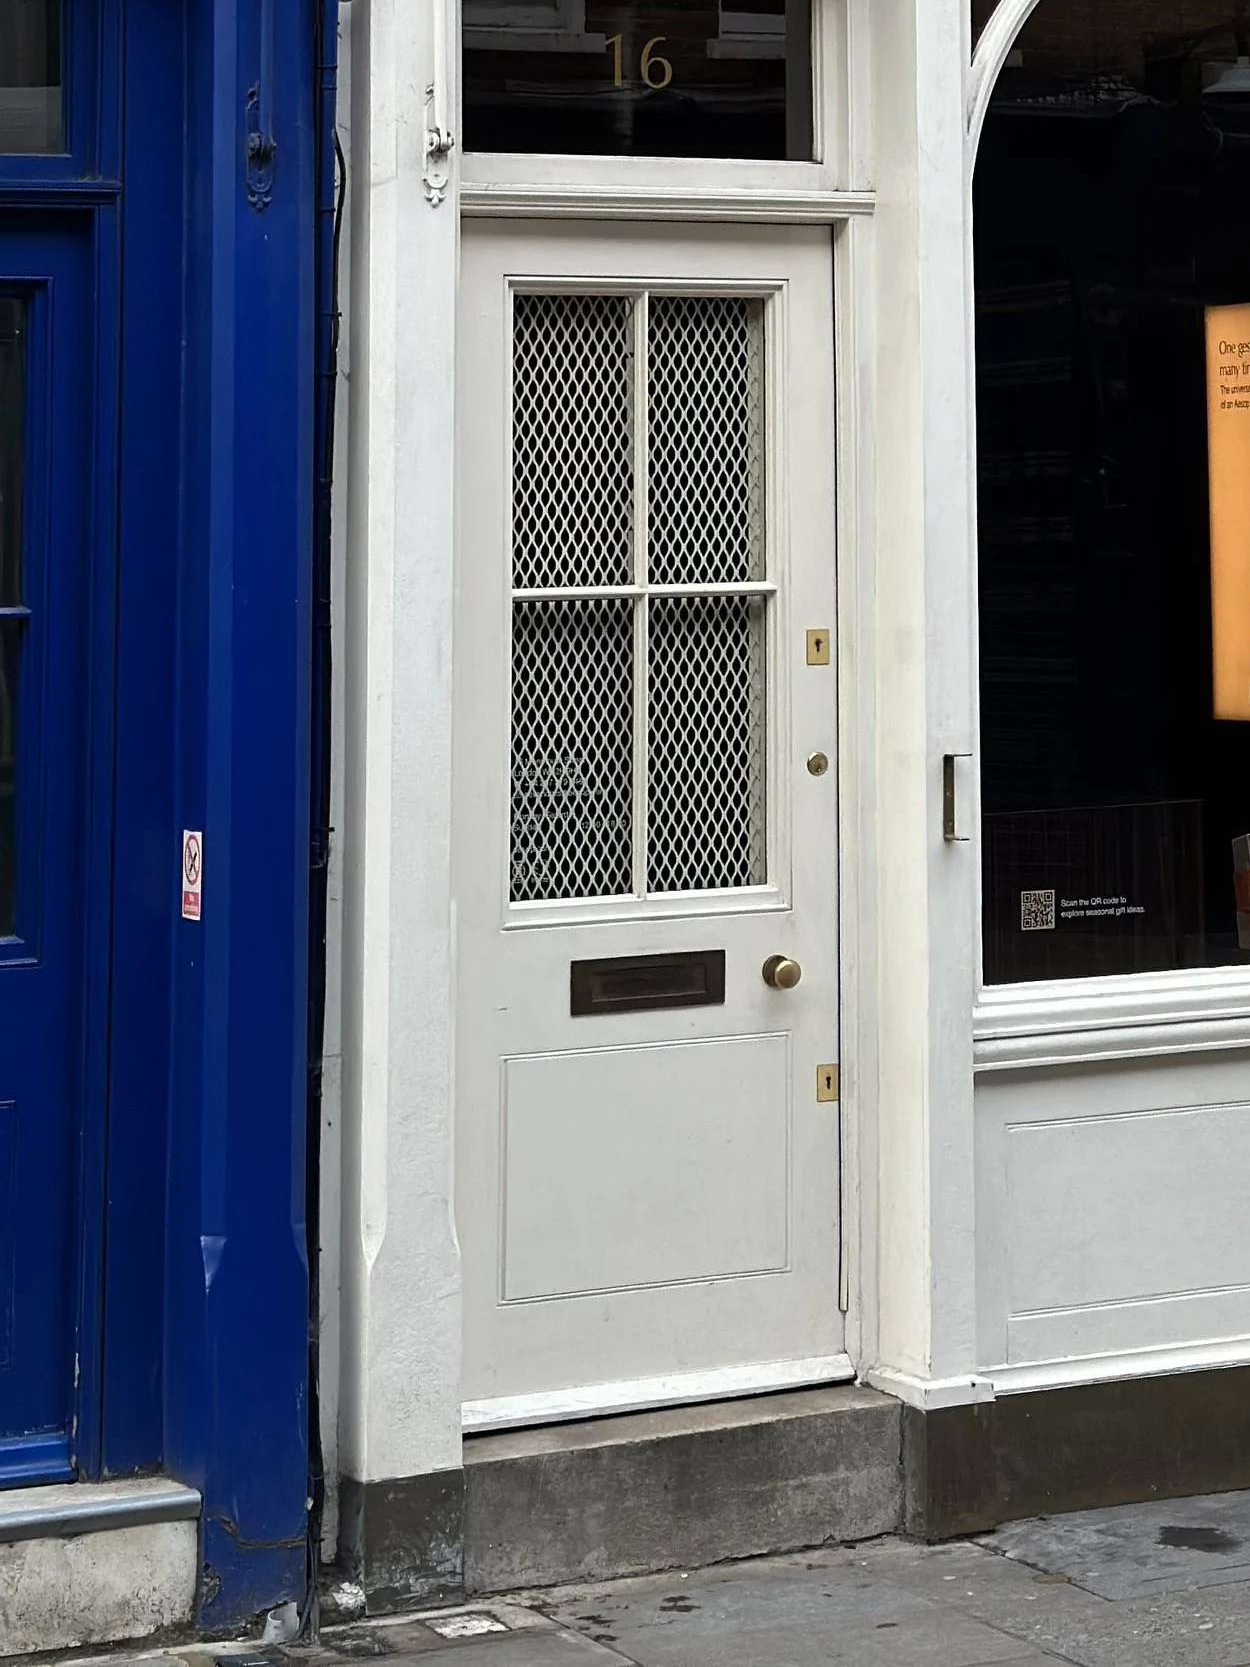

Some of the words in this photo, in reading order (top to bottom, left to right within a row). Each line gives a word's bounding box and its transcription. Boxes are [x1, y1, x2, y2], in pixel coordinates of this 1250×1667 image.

[605, 34, 673, 89] 16
[1219, 340, 1236, 355] One
[1219, 365, 1240, 380] many
[1220, 385, 1230, 394] The
[1060, 899, 1078, 907] Scan
[1090, 897, 1102, 905] QR
[1103, 897, 1119, 905] code
[1060, 909, 1084, 918] explore
